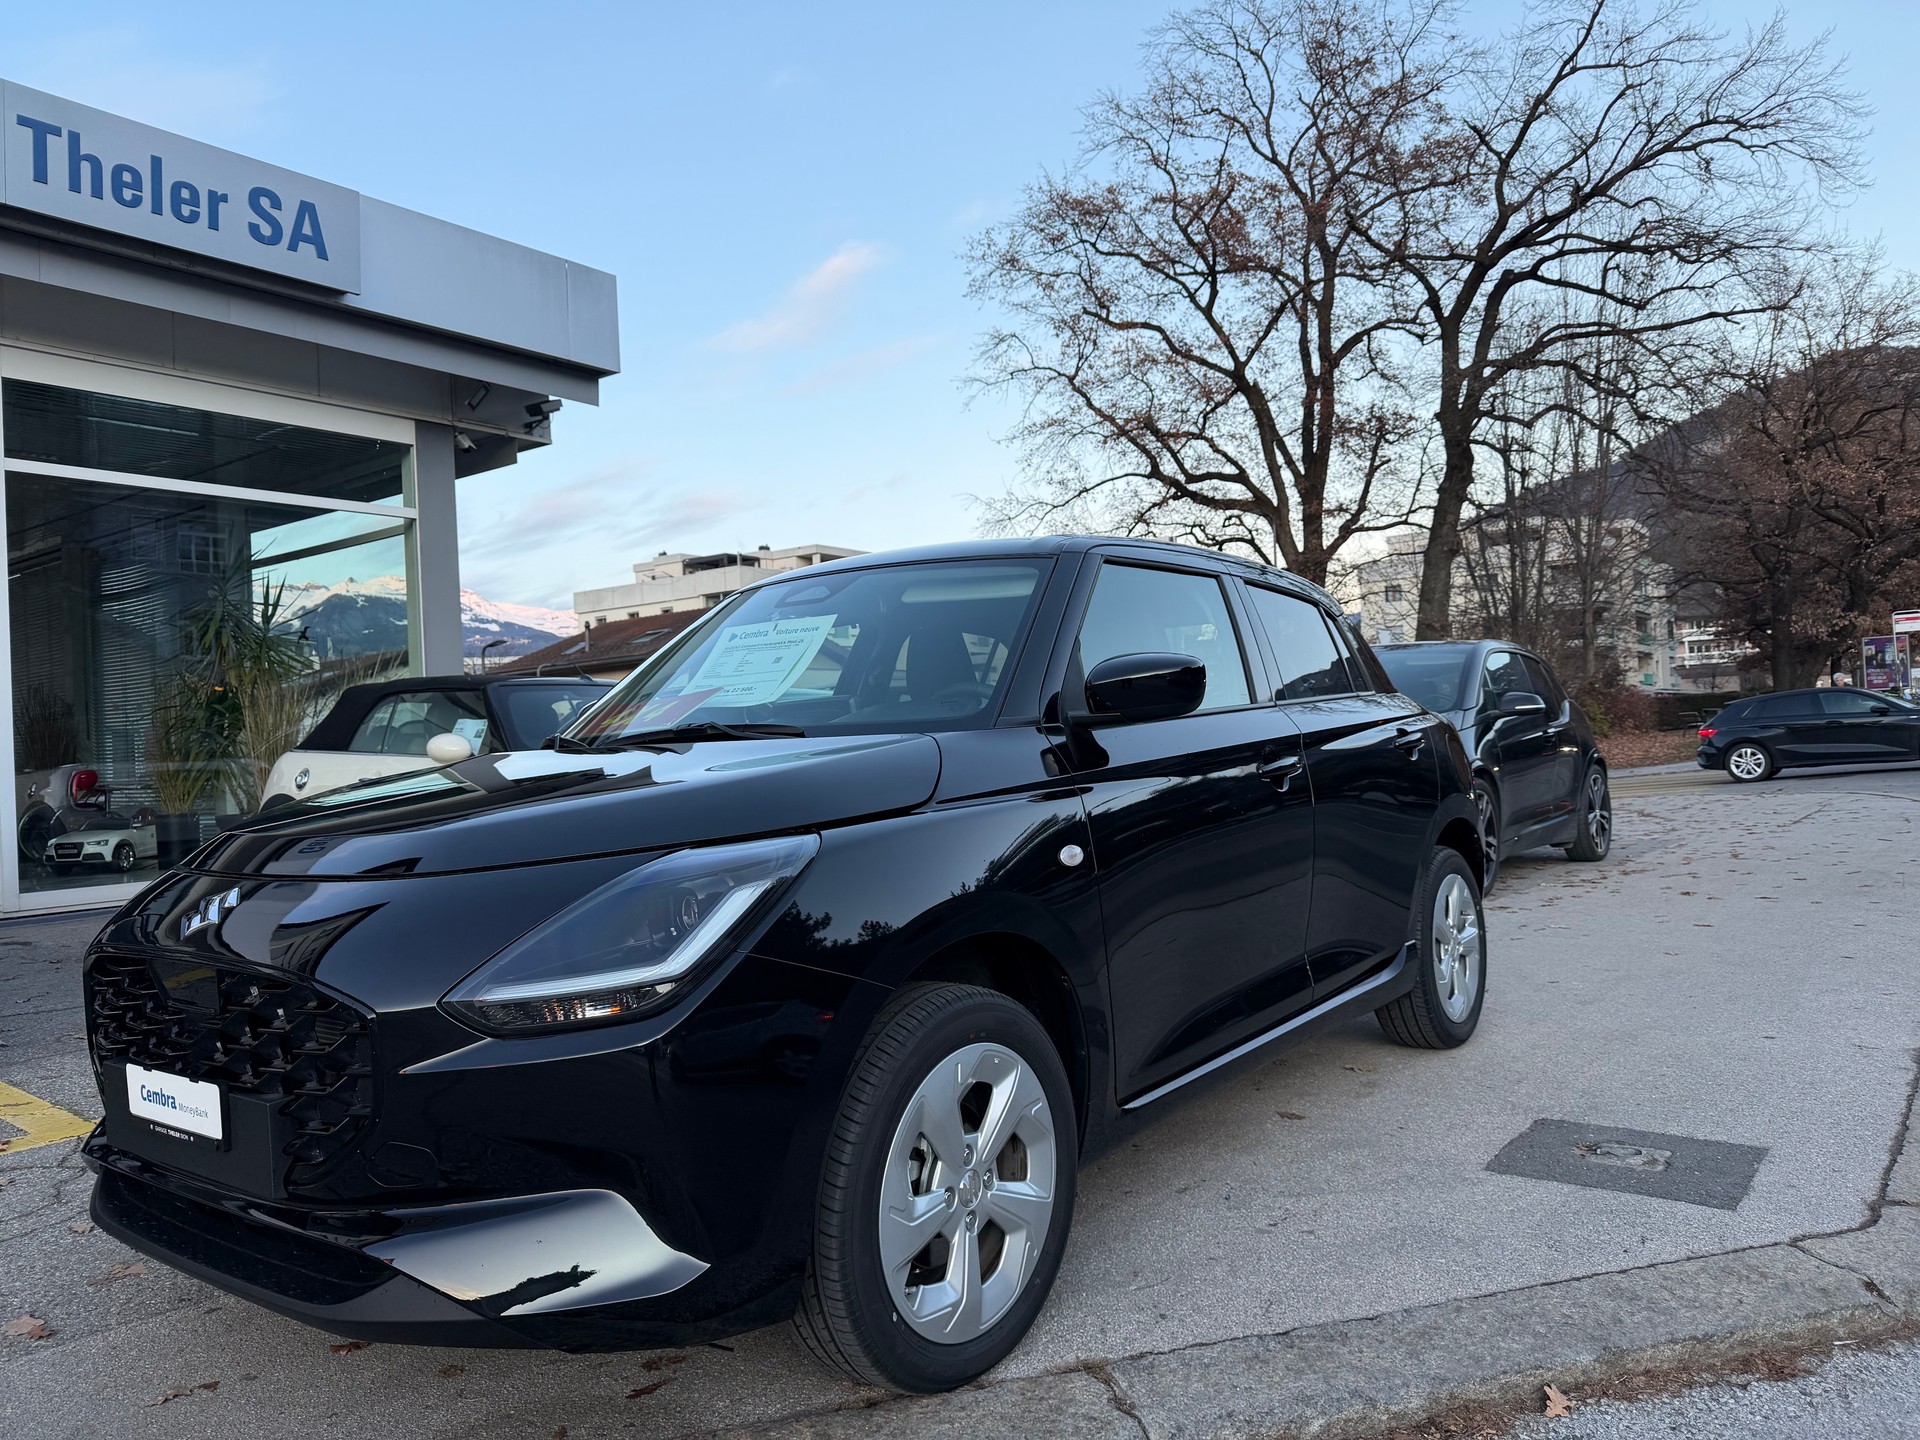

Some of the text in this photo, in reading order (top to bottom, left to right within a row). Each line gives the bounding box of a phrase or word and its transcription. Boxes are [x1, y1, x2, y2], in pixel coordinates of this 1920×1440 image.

[16, 113, 329, 261] Theler SA
[739, 630, 769, 640] Cembra
[140, 1084, 209, 1119] Cembra MoneyBank
